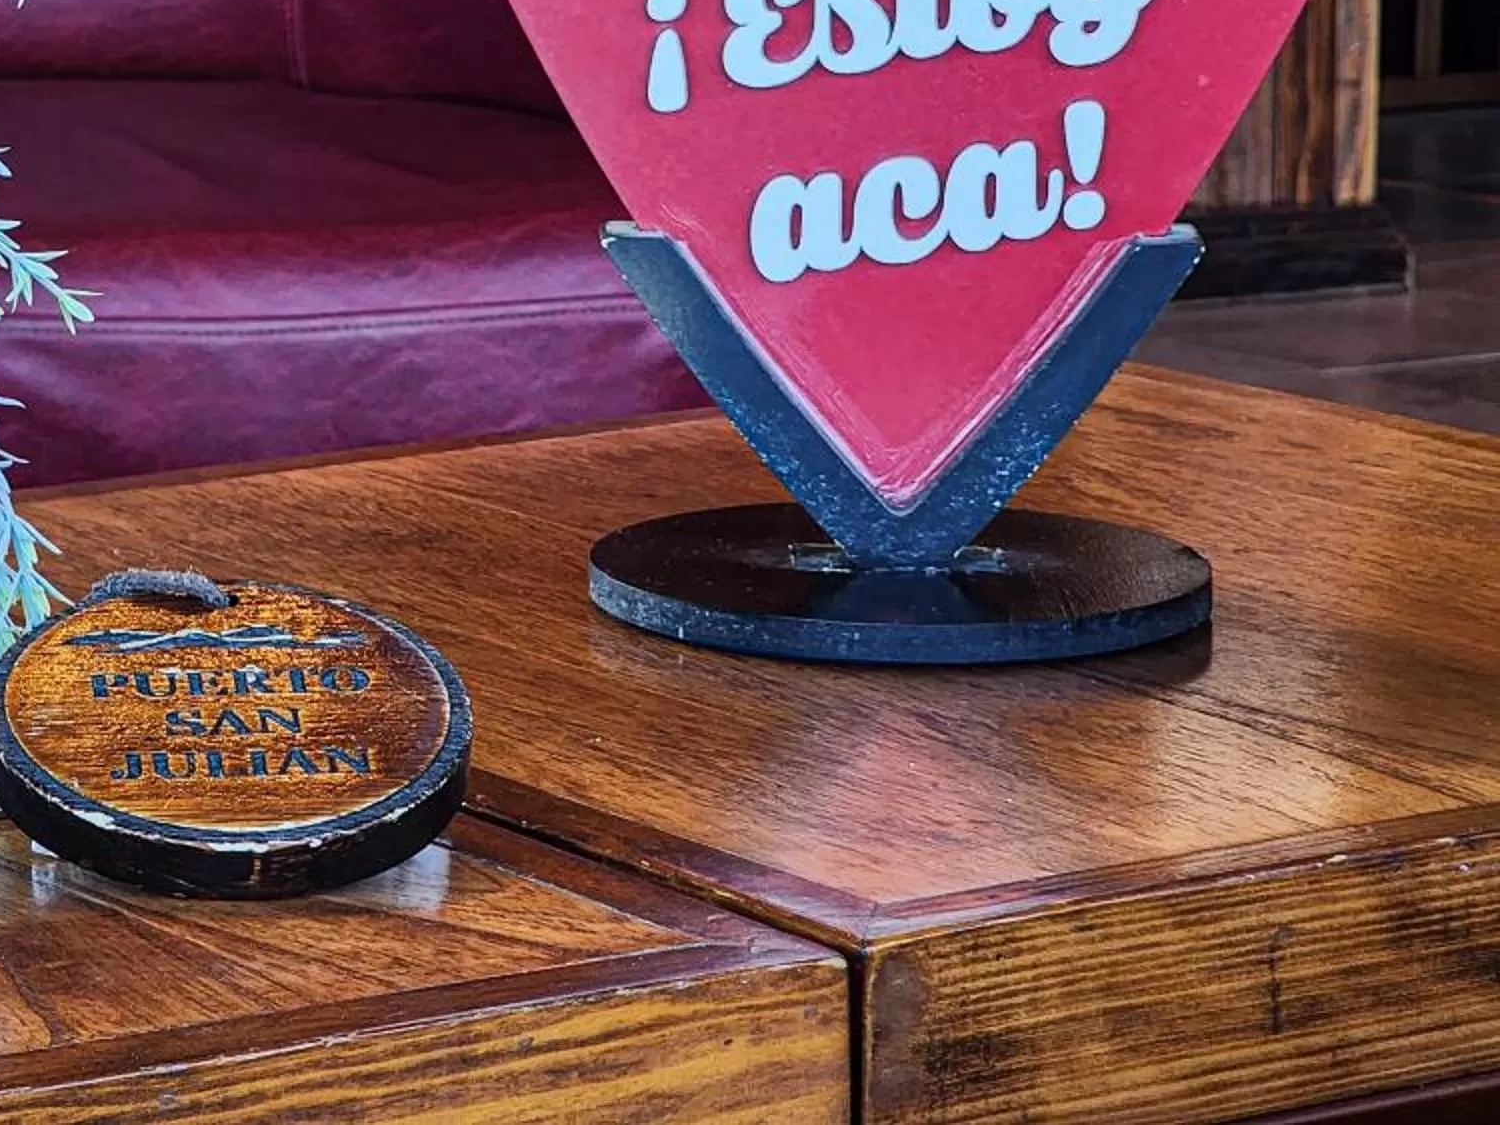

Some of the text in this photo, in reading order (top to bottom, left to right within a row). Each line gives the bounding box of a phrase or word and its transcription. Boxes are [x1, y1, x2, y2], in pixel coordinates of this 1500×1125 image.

[749, 99, 1106, 283] aca!
[90, 665, 372, 699] PUERTO
[164, 708, 302, 737] SAN
[110, 747, 373, 780] JULIAN
